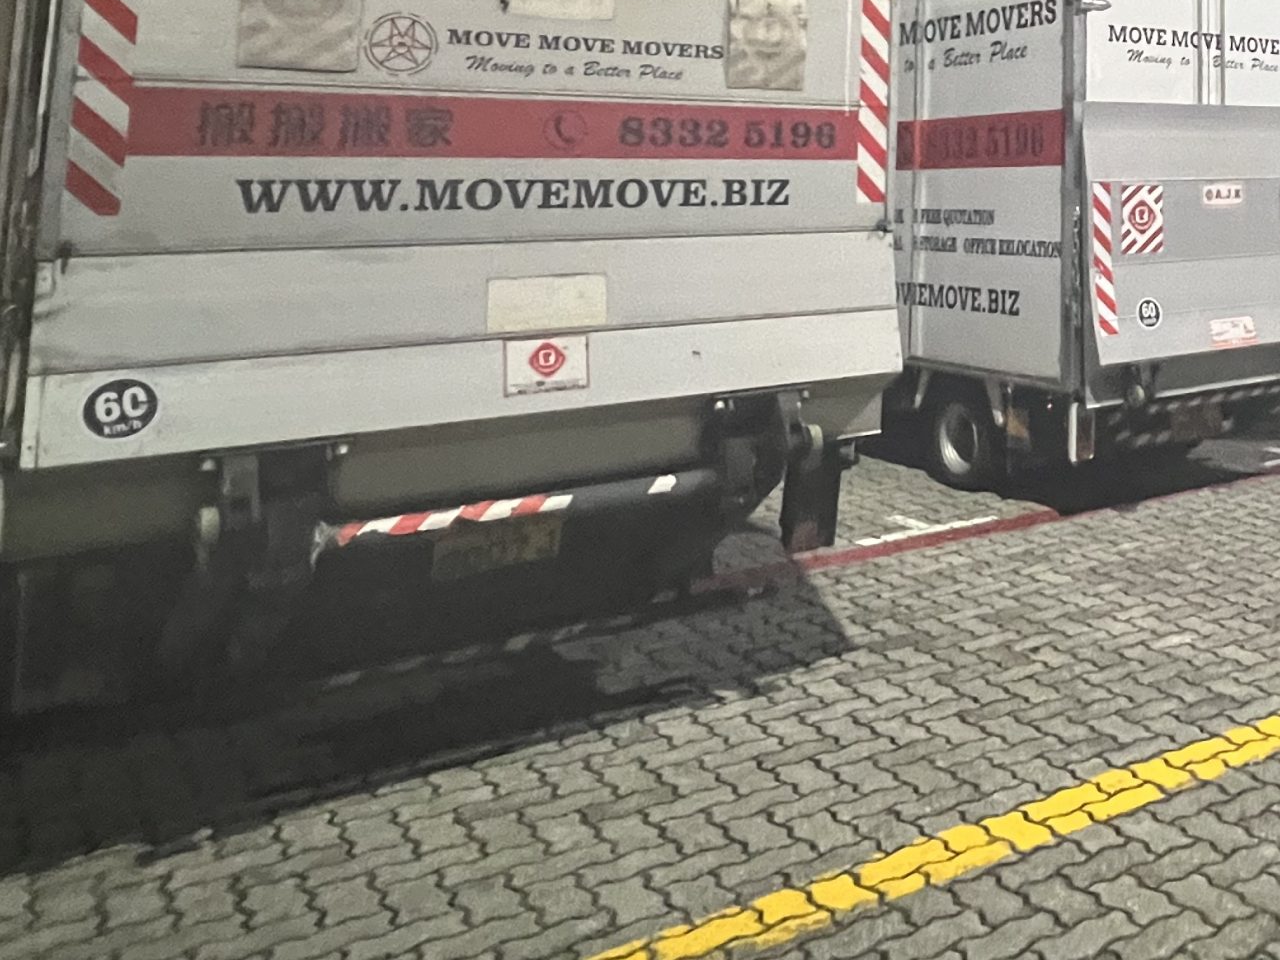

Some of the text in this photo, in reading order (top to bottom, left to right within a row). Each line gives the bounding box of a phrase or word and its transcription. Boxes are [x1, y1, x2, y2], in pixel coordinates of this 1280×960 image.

[447, 28, 725, 60] MOVE MOVE MOVERS
[1108, 25, 1167, 46] MOVE
[465, 55, 683, 80] Moving to a Better Place
[943, 47, 981, 68] Better
[989, 41, 1028, 63] Place
[1127, 49, 1279, 73] Moving to Btter Place
[618, 116, 837, 149] 8332 5196
[235, 178, 790, 213] WWW.MOVEMOVE.BIZ
[1142, 302, 1156, 317] 60
[95, 386, 148, 423] 60
